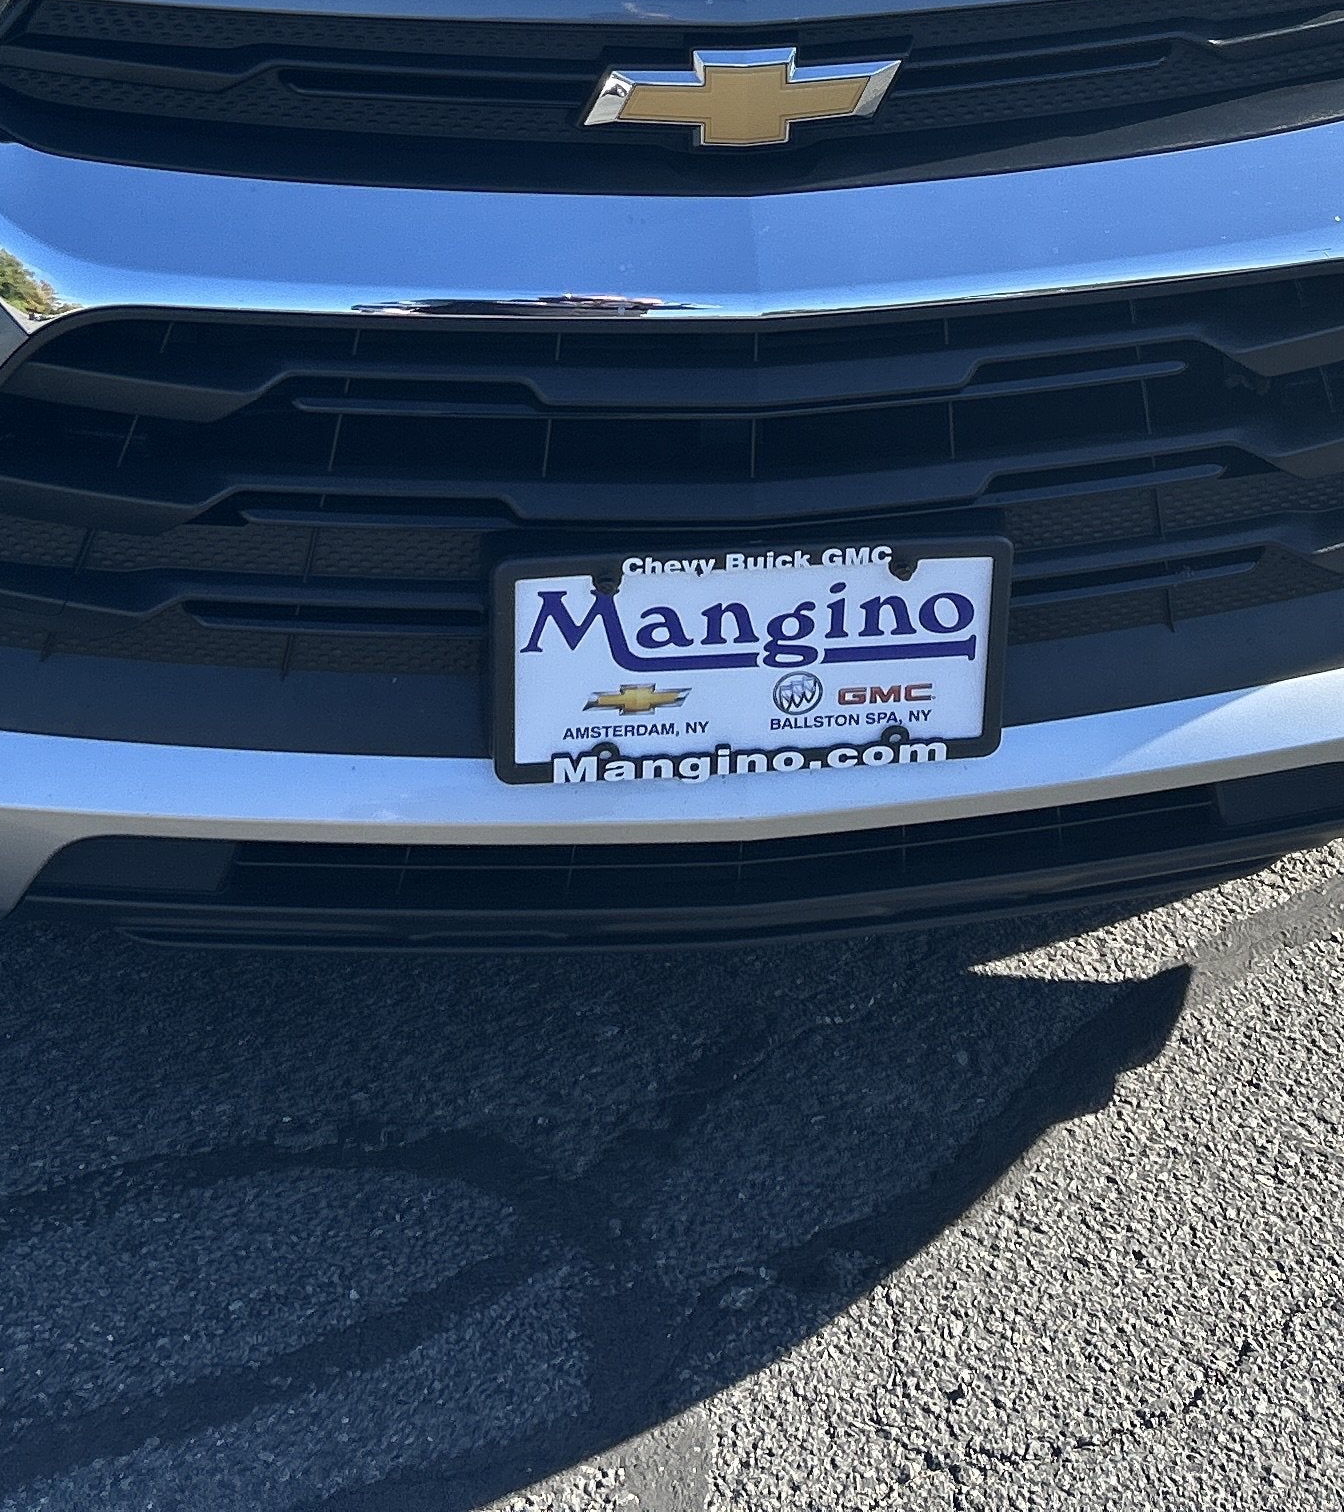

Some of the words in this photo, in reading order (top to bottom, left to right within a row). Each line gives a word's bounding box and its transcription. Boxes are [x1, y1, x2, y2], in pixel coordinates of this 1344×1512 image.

[621, 557, 716, 577] Chevy
[726, 550, 810, 571] Buick
[821, 545, 893, 568] GMC
[519, 581, 977, 672] Mangino
[837, 682, 934, 706] GMC
[562, 721, 680, 741] AMSTERDAM,
[685, 720, 710, 735] NY
[769, 713, 860, 731] BALLSTON
[865, 710, 904, 726] SPA,
[908, 709, 933, 723] NY
[553, 741, 948, 784] Mangino.com
